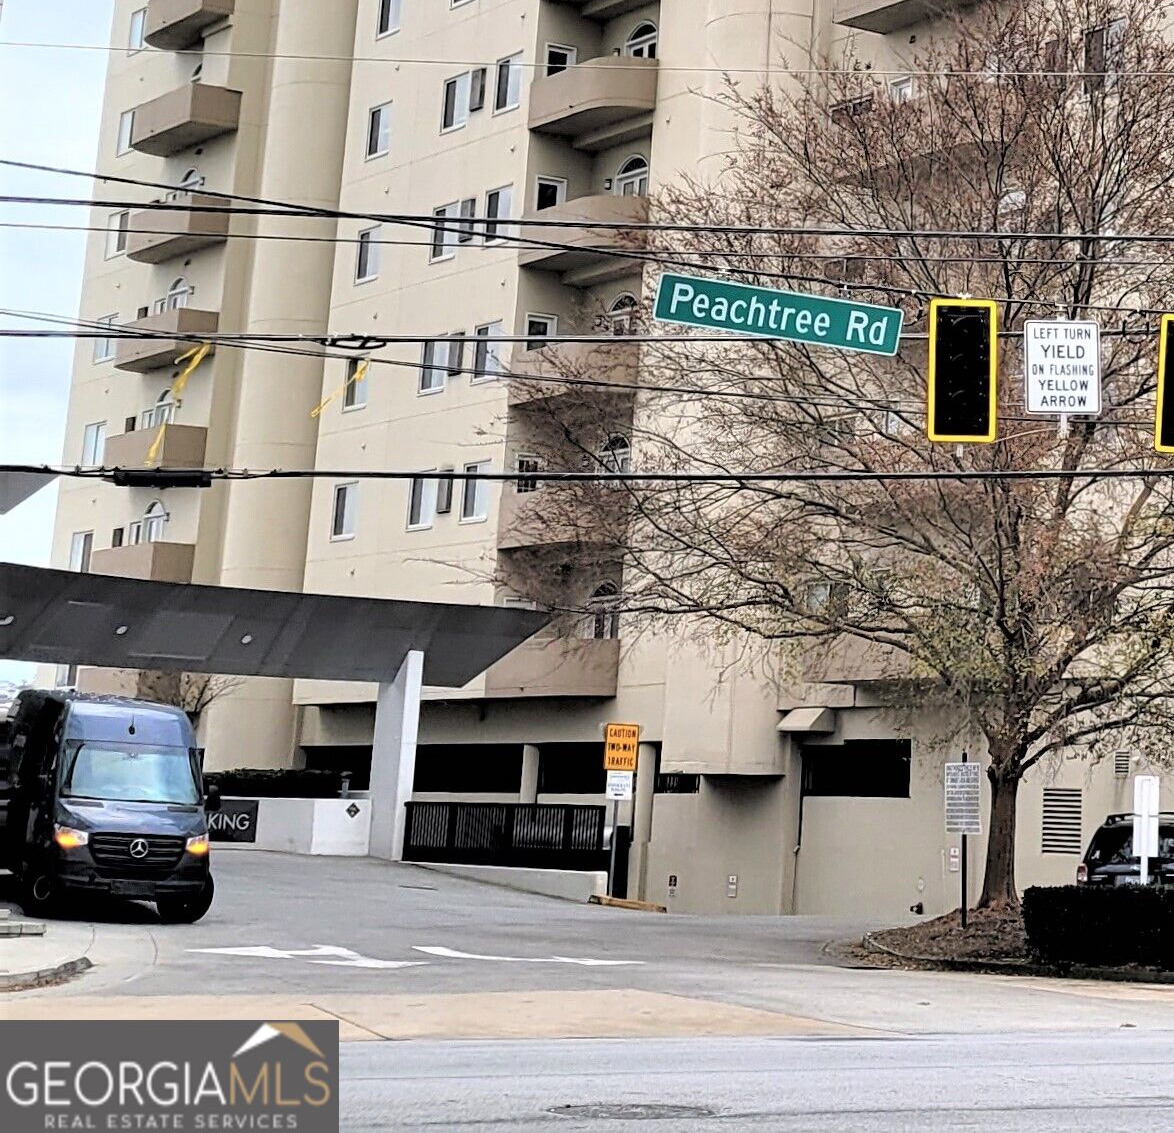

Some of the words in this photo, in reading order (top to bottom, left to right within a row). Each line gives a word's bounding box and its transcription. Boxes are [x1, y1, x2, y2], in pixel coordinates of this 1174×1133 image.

[669, 282, 831, 337] Peachtree
[846, 310, 889, 346] Rd
[1033, 328, 1059, 340] LEFT
[1064, 328, 1091, 340] TURN
[1040, 345, 1085, 359] YIELD
[1032, 364, 1044, 375] ON
[1050, 364, 1094, 376] FLASHING
[1039, 380, 1089, 392] YELLOW
[1040, 396, 1087, 407] ARROW
[609, 728, 637, 738] CAUTION
[608, 742, 635, 753] TWO-WAY
[608, 757, 634, 767] TRAFFIC
[208, 813, 250, 830] KING
